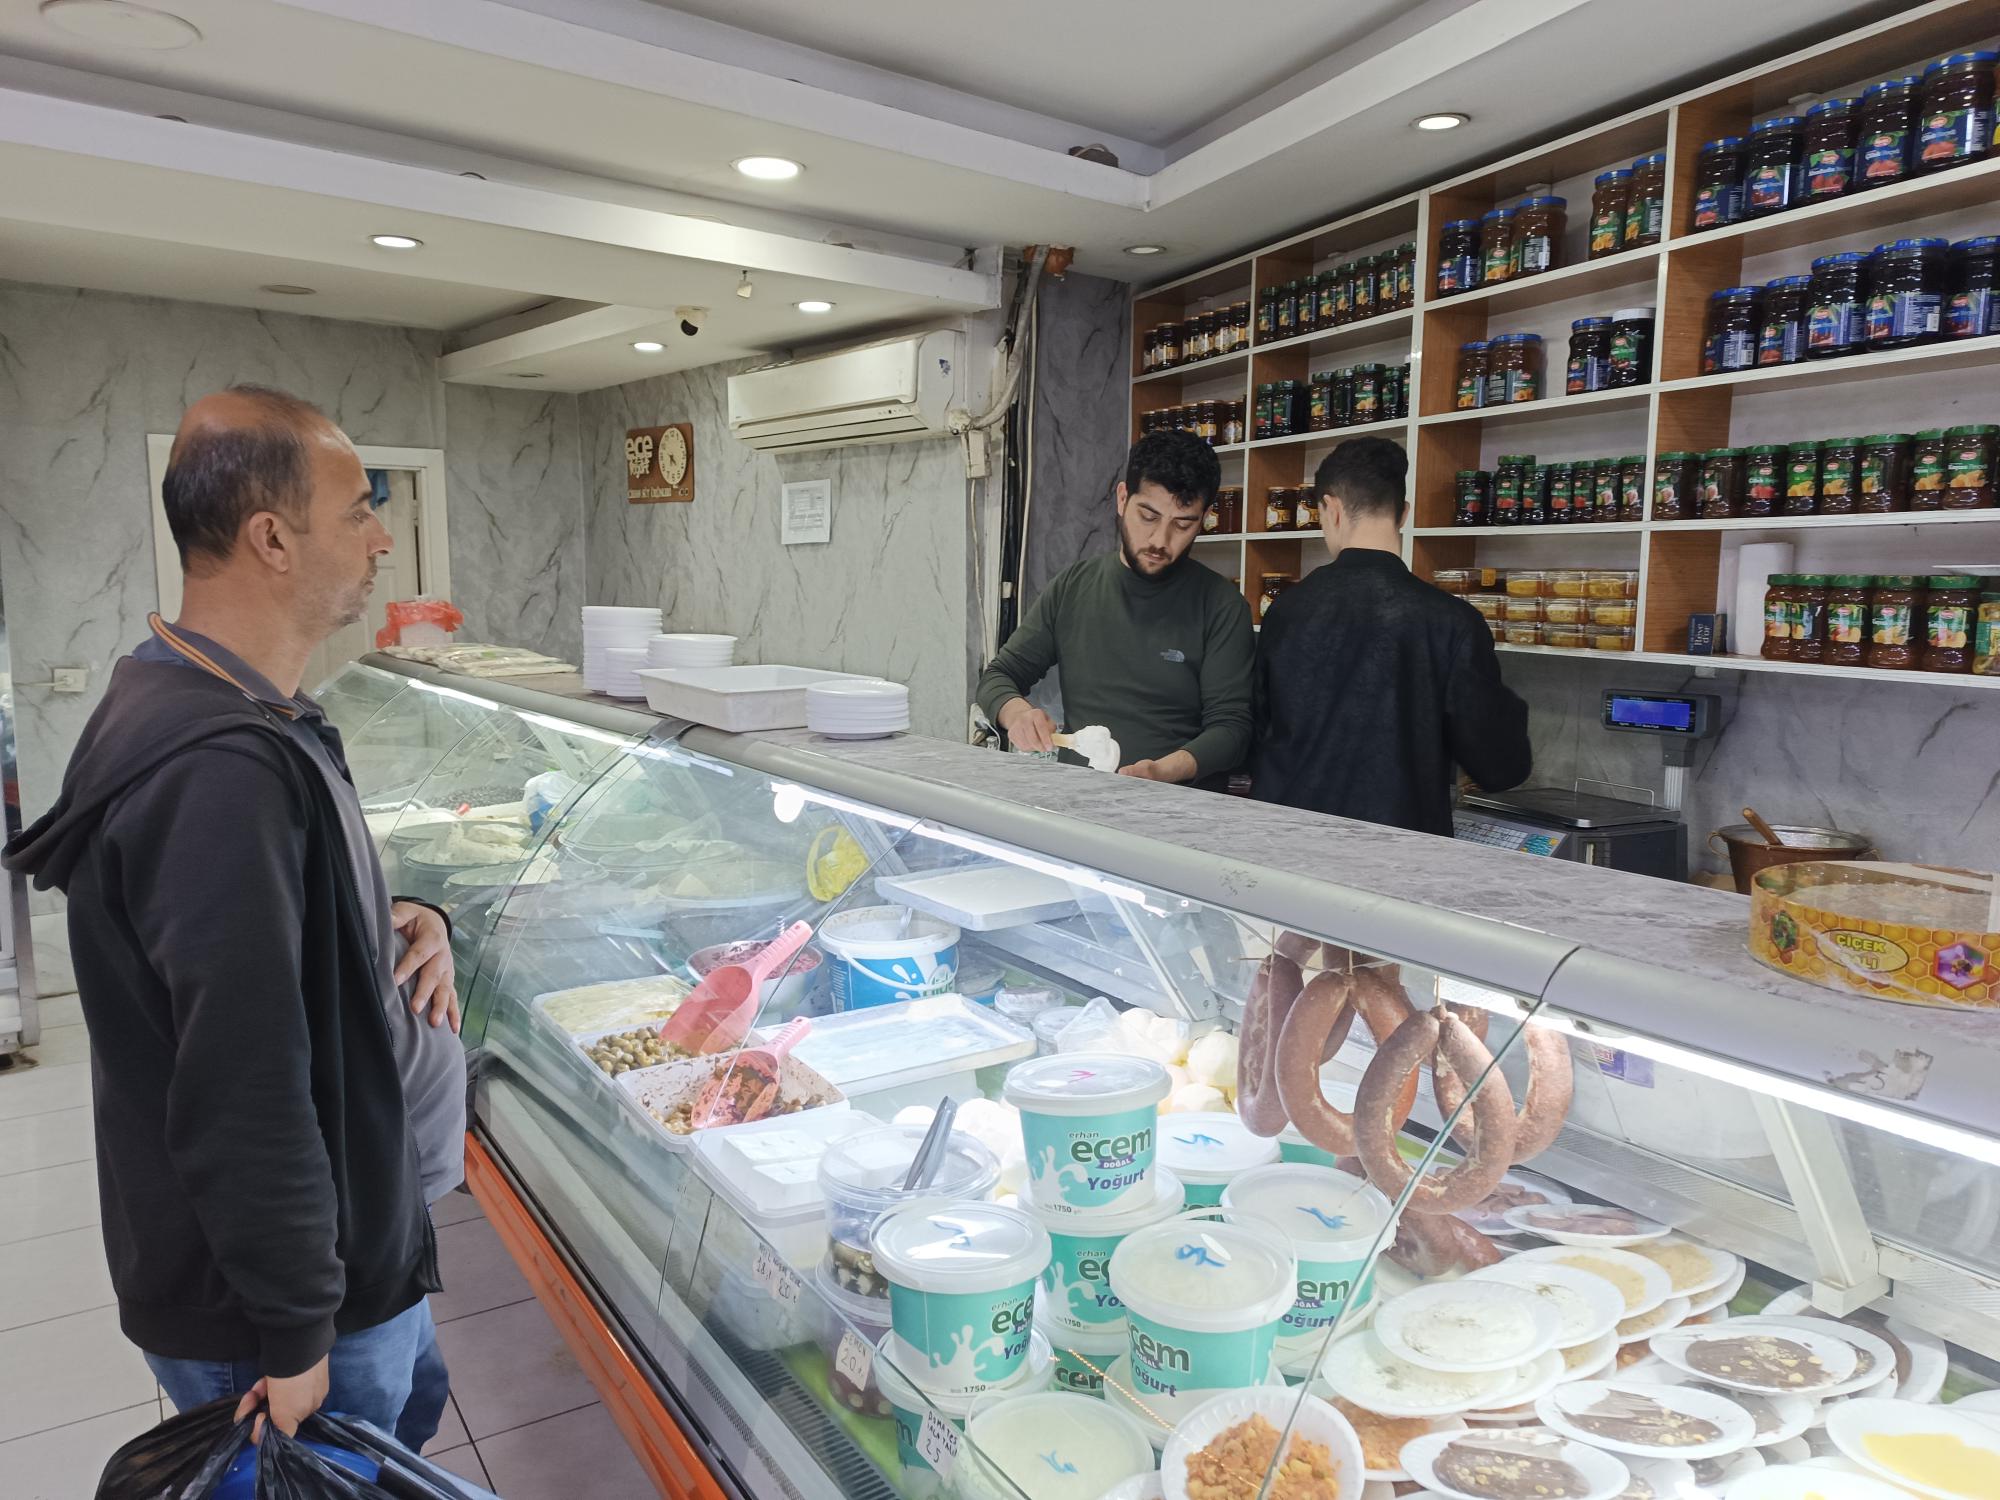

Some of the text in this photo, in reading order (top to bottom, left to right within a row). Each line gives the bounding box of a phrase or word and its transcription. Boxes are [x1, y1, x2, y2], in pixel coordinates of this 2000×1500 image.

[1070, 1128, 1151, 1163] ecem
[1103, 1158, 1131, 1169] DOĞAL
[1087, 1168, 1145, 1191] Yoğurt
[1054, 1204, 1072, 1213] 1750
[1077, 1250, 1106, 1258] erhan
[992, 1294, 1033, 1335] ece
[1282, 1313, 1335, 1328] oğurt
[1064, 1318, 1082, 1328] 1750
[1130, 1325, 1190, 1372] cem
[964, 1385, 985, 1393] 1750
